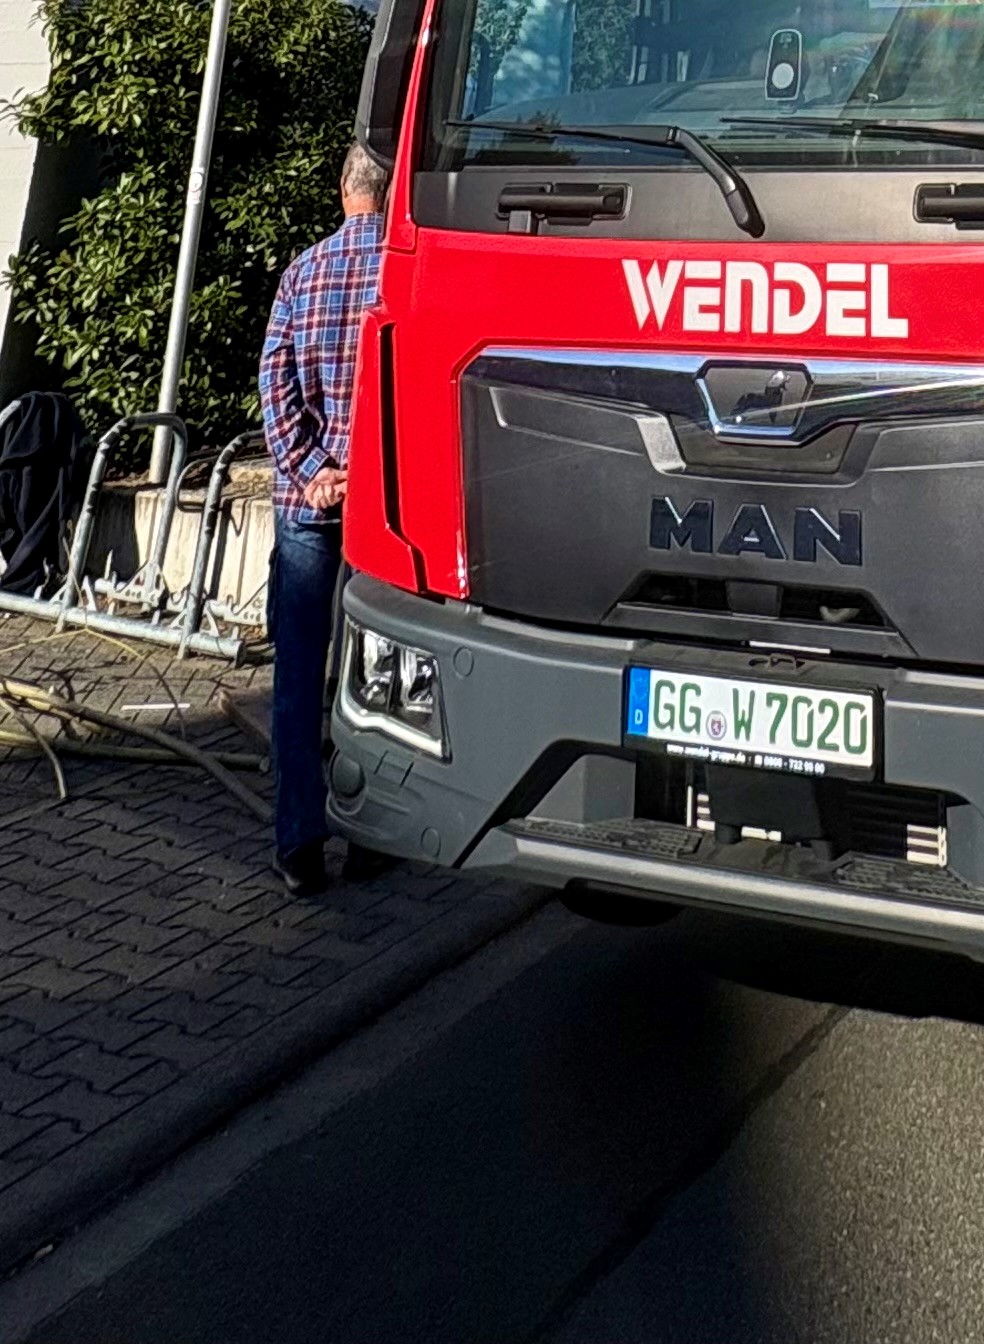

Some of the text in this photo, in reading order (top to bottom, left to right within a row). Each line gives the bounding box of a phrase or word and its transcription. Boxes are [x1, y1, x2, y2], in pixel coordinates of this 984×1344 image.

[622, 259, 909, 339] WENDEL
[649, 496, 863, 566] MAN
[634, 679, 868, 755] D GG W 7020
